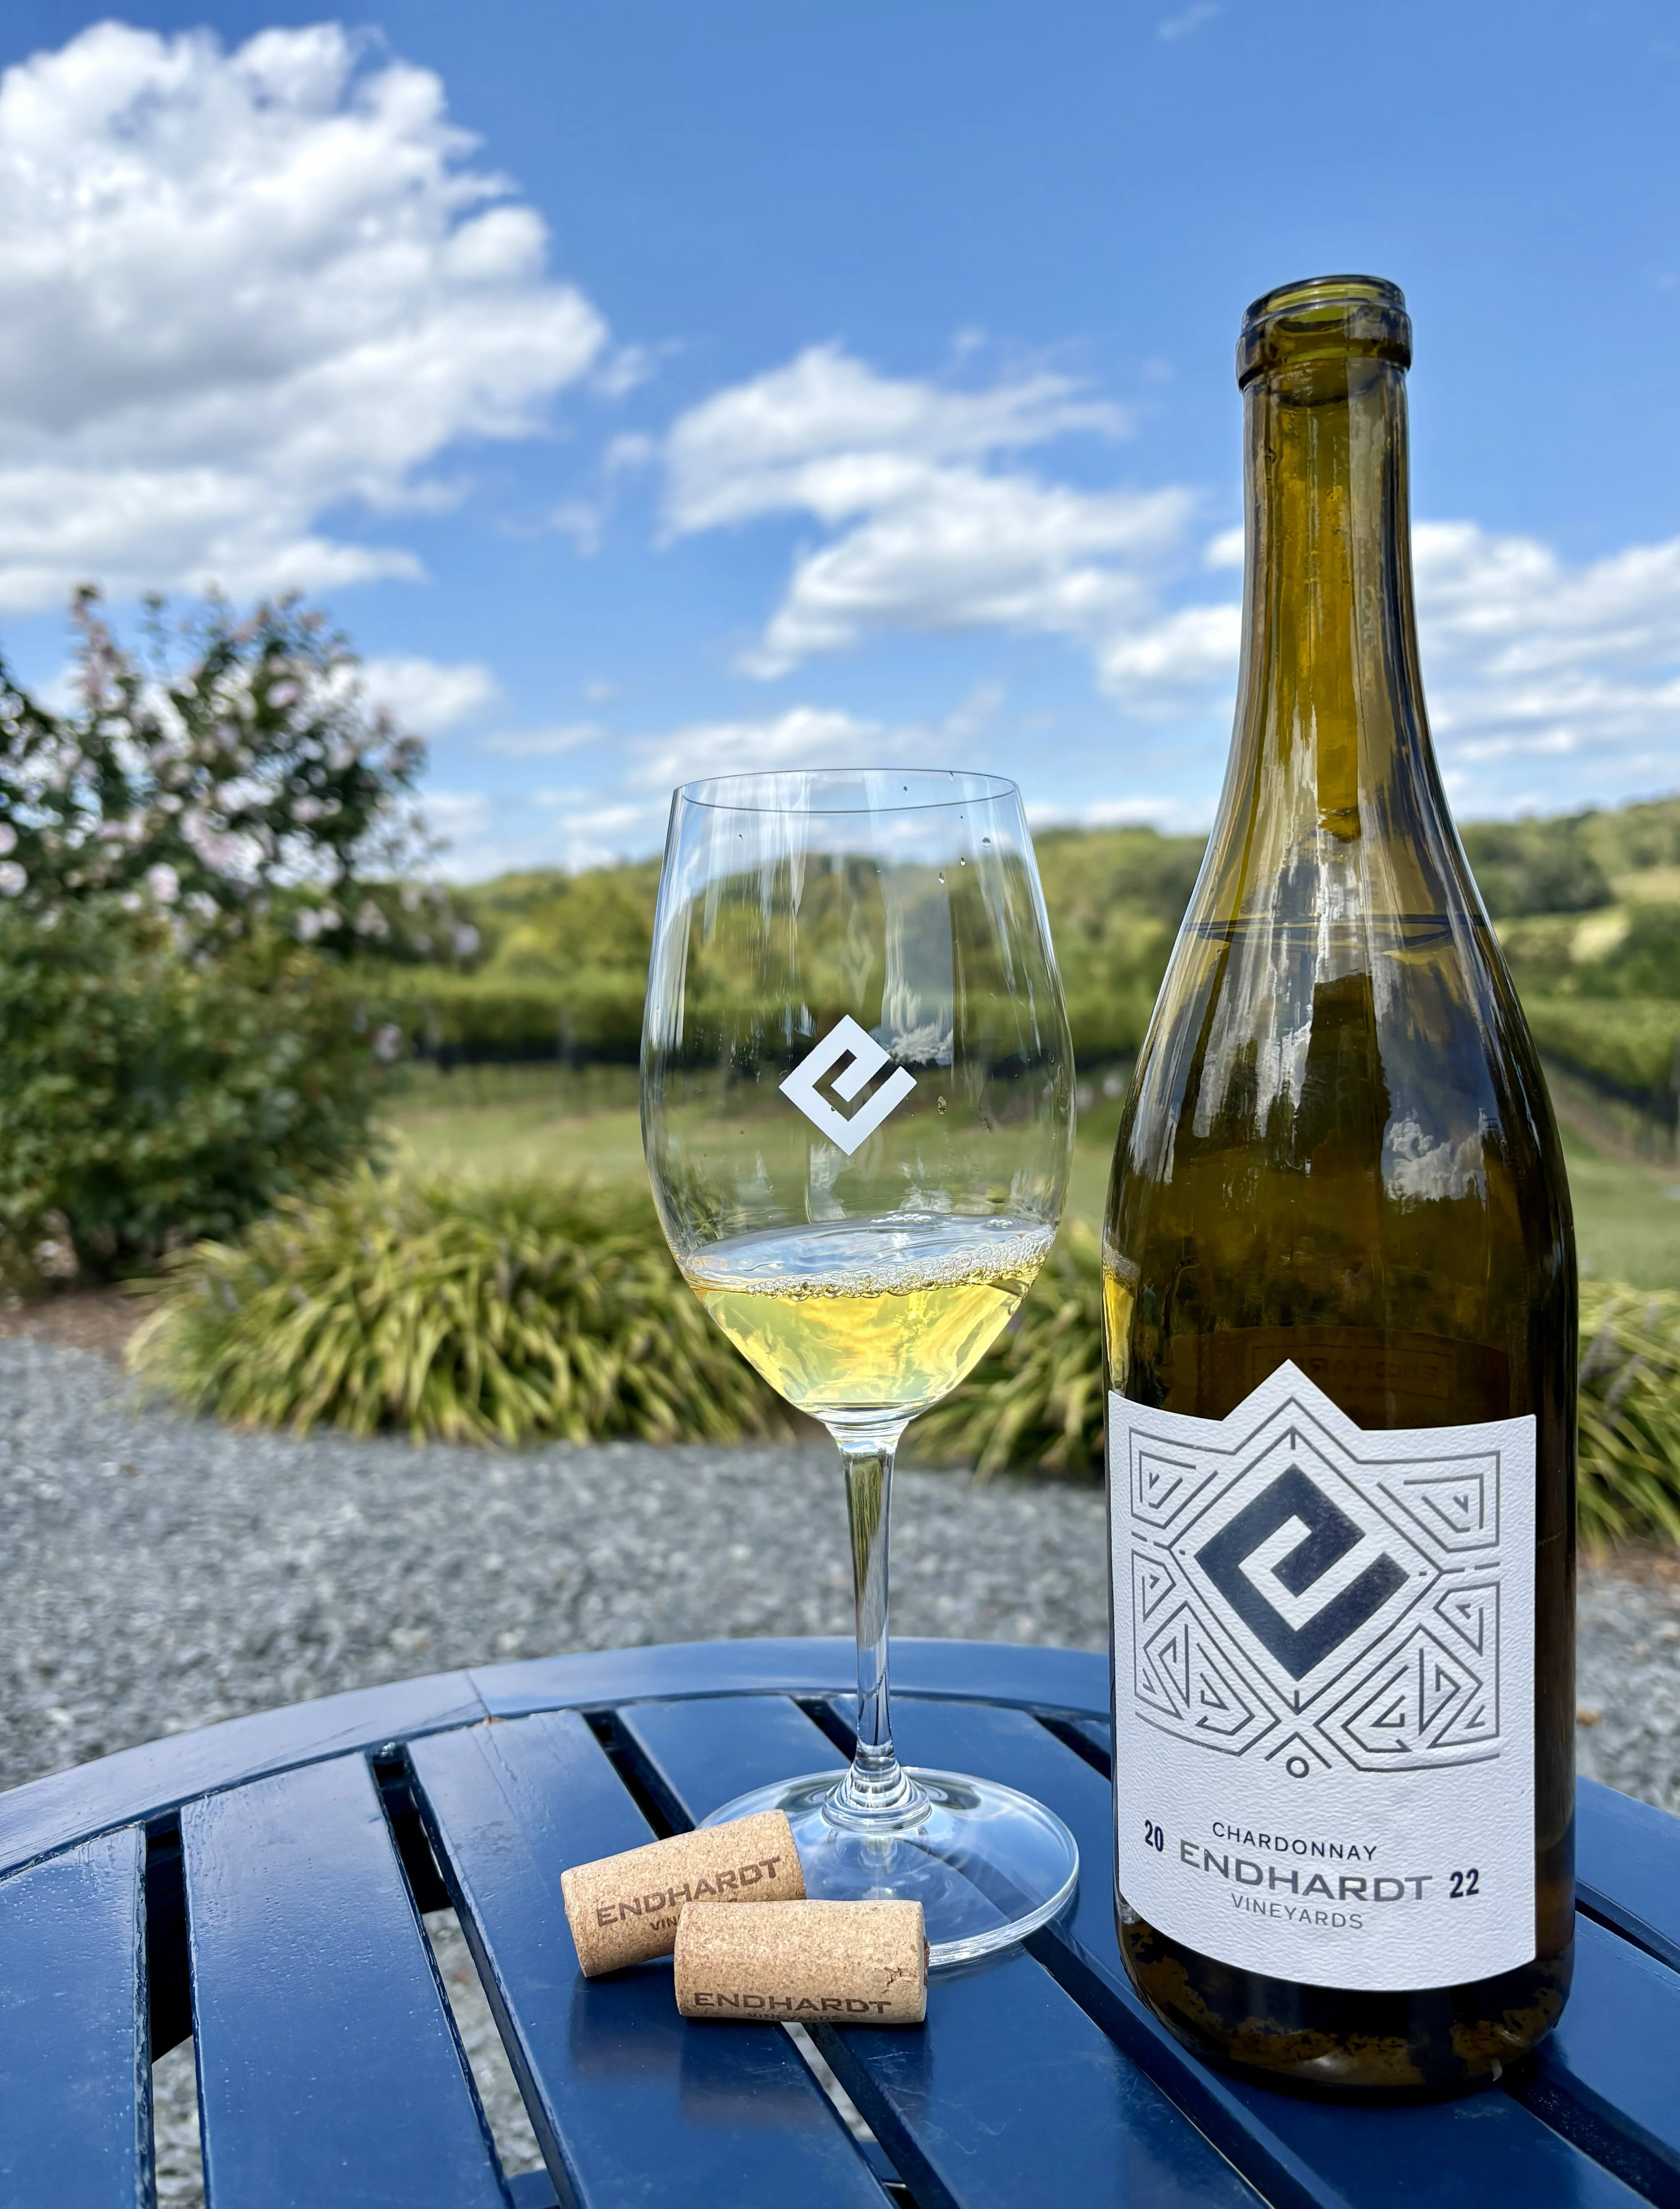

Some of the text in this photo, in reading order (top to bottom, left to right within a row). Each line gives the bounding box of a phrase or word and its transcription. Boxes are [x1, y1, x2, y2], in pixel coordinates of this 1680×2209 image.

[1212, 1821, 1378, 1861] CHARDONNAY
[1144, 1819, 1479, 1902] 20 ENDHARDT 22
[596, 1856, 780, 1927] ENDHARDT
[1231, 1893, 1363, 1930] VINEYARDS
[694, 1992, 891, 2014] ENDHARDT
[747, 2012, 841, 2021] VINEYARDS
